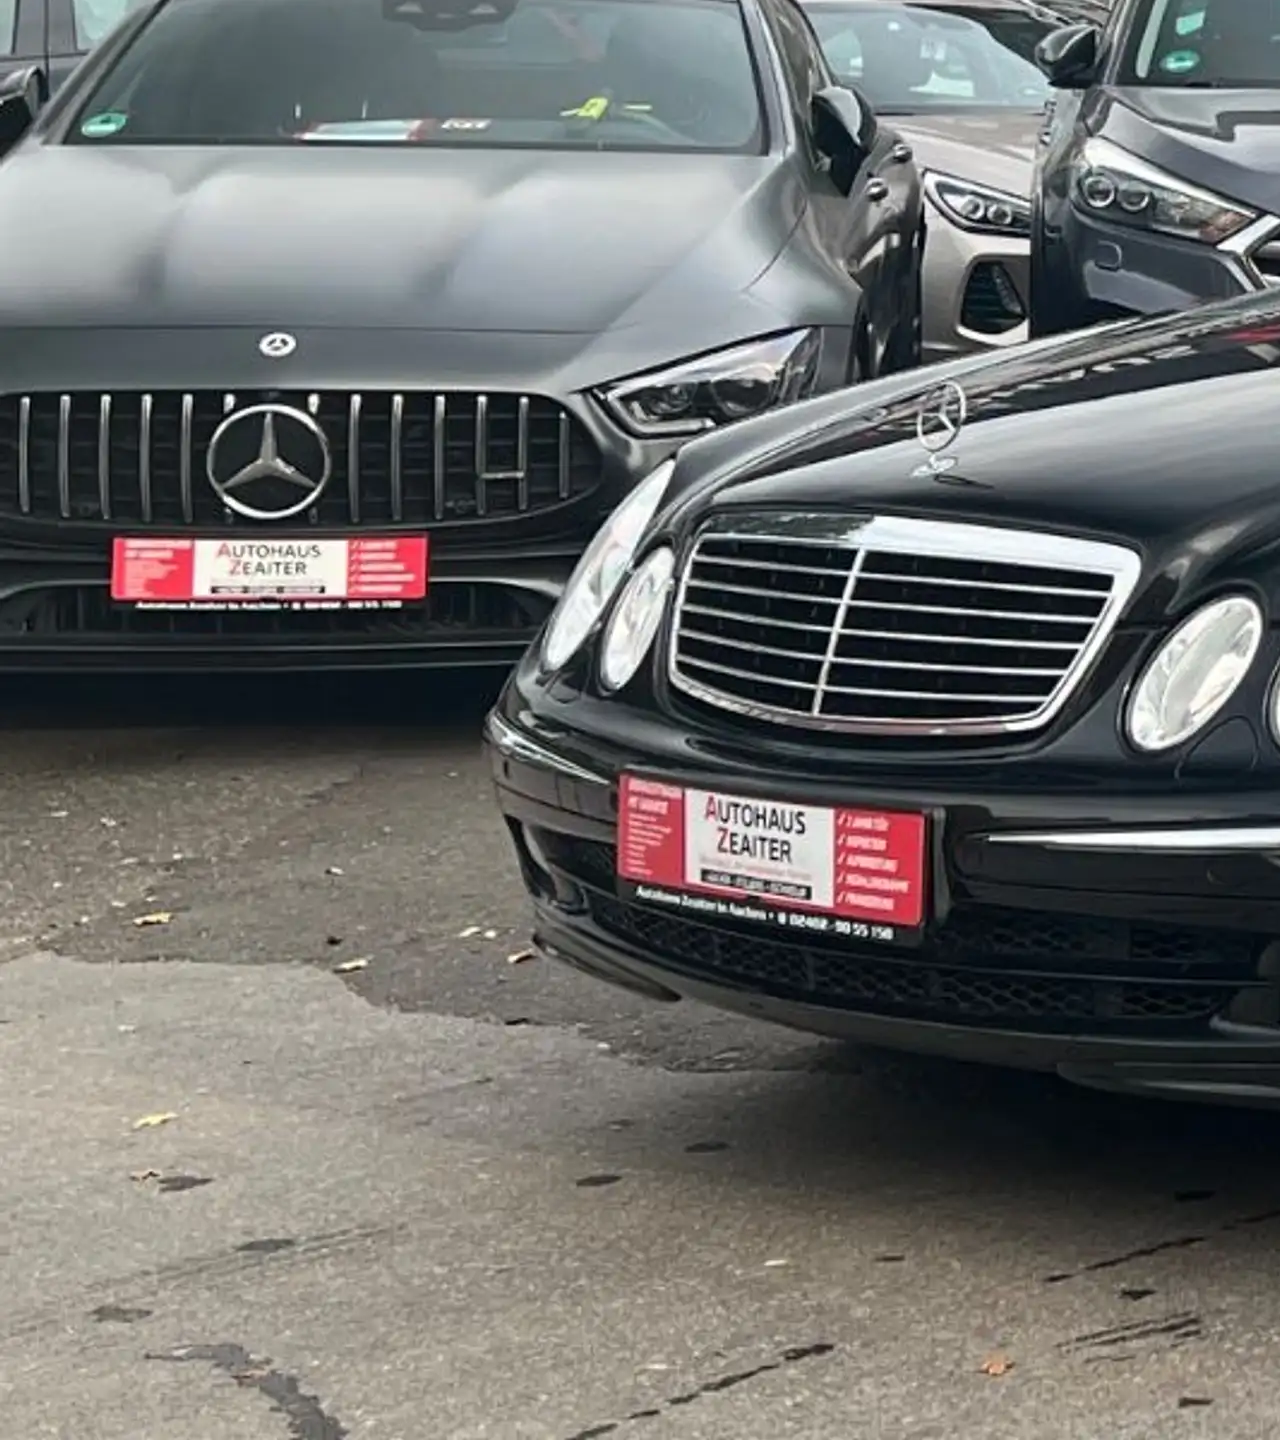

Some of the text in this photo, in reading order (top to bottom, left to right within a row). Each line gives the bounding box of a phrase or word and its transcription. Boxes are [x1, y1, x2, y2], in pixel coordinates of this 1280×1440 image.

[217, 542, 322, 559] AUTOHAUS
[229, 560, 307, 576] ZEAITER
[704, 794, 807, 836] AUTOHAUS
[716, 826, 793, 863] ZEAITER
